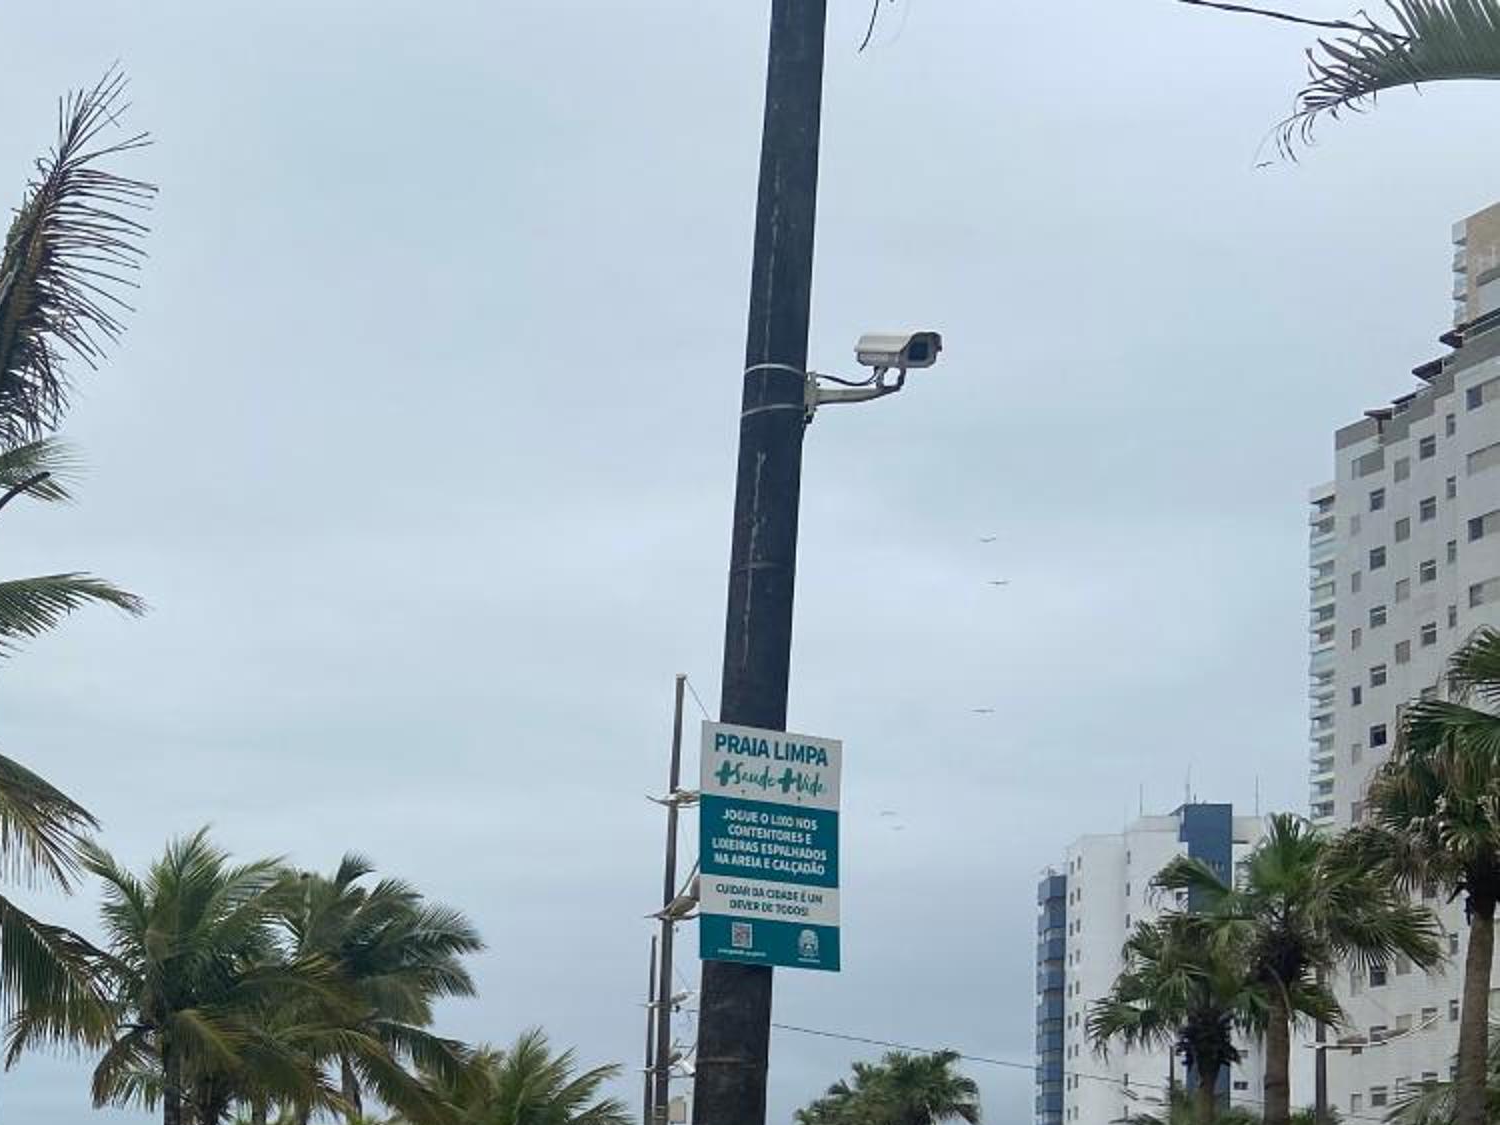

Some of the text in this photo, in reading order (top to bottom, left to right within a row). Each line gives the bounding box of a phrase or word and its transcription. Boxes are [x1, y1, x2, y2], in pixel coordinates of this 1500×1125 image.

[715, 733, 828, 767] PRAIA LIMPA
[722, 808, 818, 831] JOGUE O LIXO NOS
[727, 824, 812, 845] CONTENTORES E
[712, 838, 827, 861] LIXEIRAS ESPALHADOS
[713, 853, 825, 876] NA AREIA E CALÇADÃO
[716, 883, 750, 897] CUIDAR
[752, 887, 765, 897] DA
[766, 889, 799, 901] CIDADE
[808, 894, 823, 904] UM
[730, 900, 760, 911] DEVER
[762, 903, 772, 912] DE
